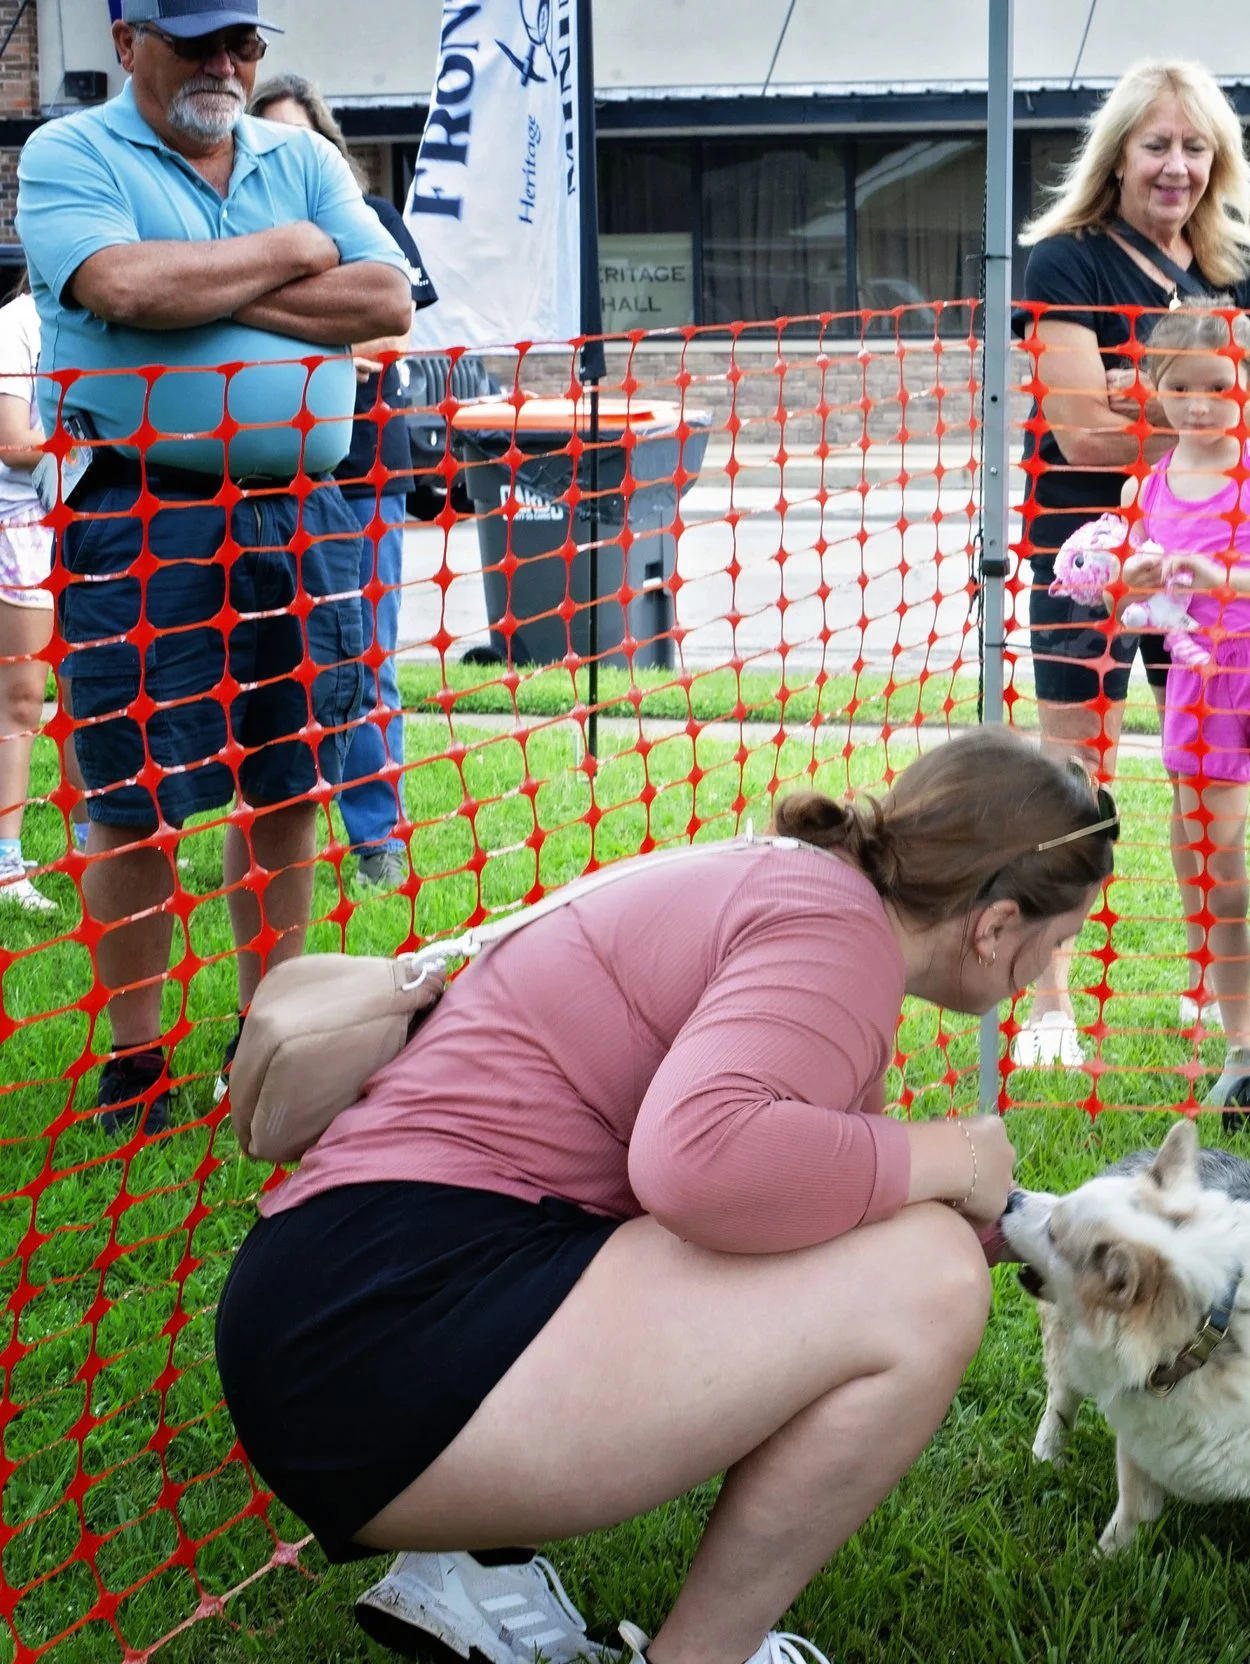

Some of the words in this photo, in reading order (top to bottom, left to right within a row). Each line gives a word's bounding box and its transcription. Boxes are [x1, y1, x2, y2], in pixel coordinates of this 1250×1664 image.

[411, 0, 482, 222] FRON
[518, 114, 542, 225] Heritage
[599, 265, 687, 283] RITAGE
[601, 295, 662, 313] HALL
